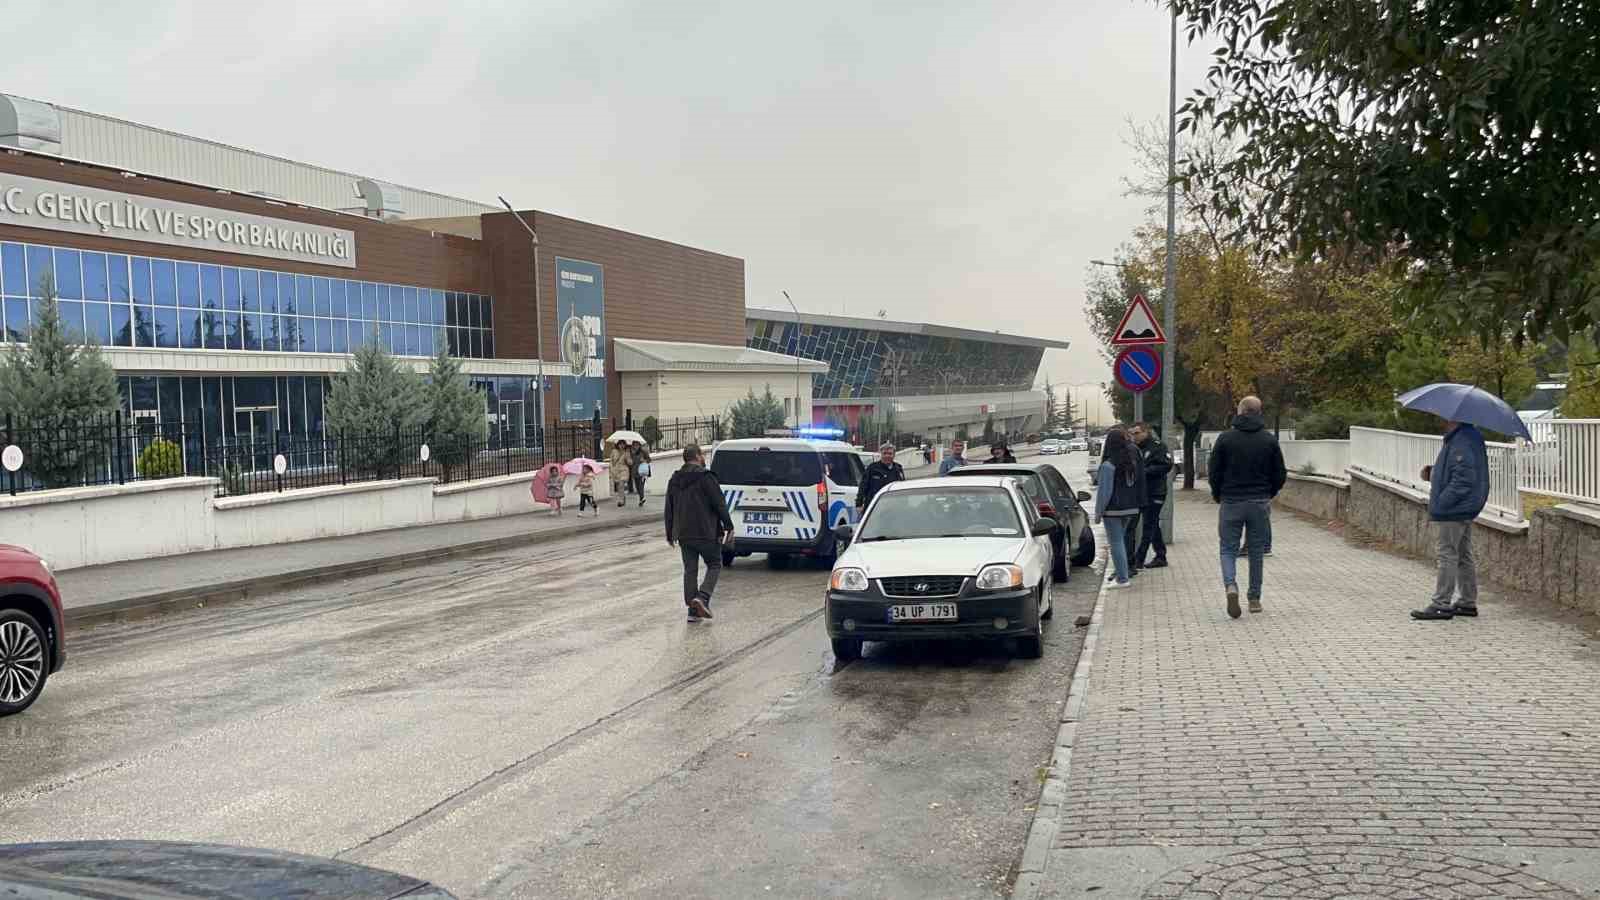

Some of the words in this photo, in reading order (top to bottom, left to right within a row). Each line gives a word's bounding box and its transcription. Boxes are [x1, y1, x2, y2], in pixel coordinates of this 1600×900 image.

[0, 184, 33, 216] .C.
[36, 191, 149, 232] GENÇLİK
[153, 208, 185, 237] VE
[189, 214, 247, 245] SPOR
[250, 226, 350, 260] BAKANLIĞI
[893, 606, 906, 618] 34
[911, 605, 924, 618] UP
[931, 605, 956, 617] 1791
